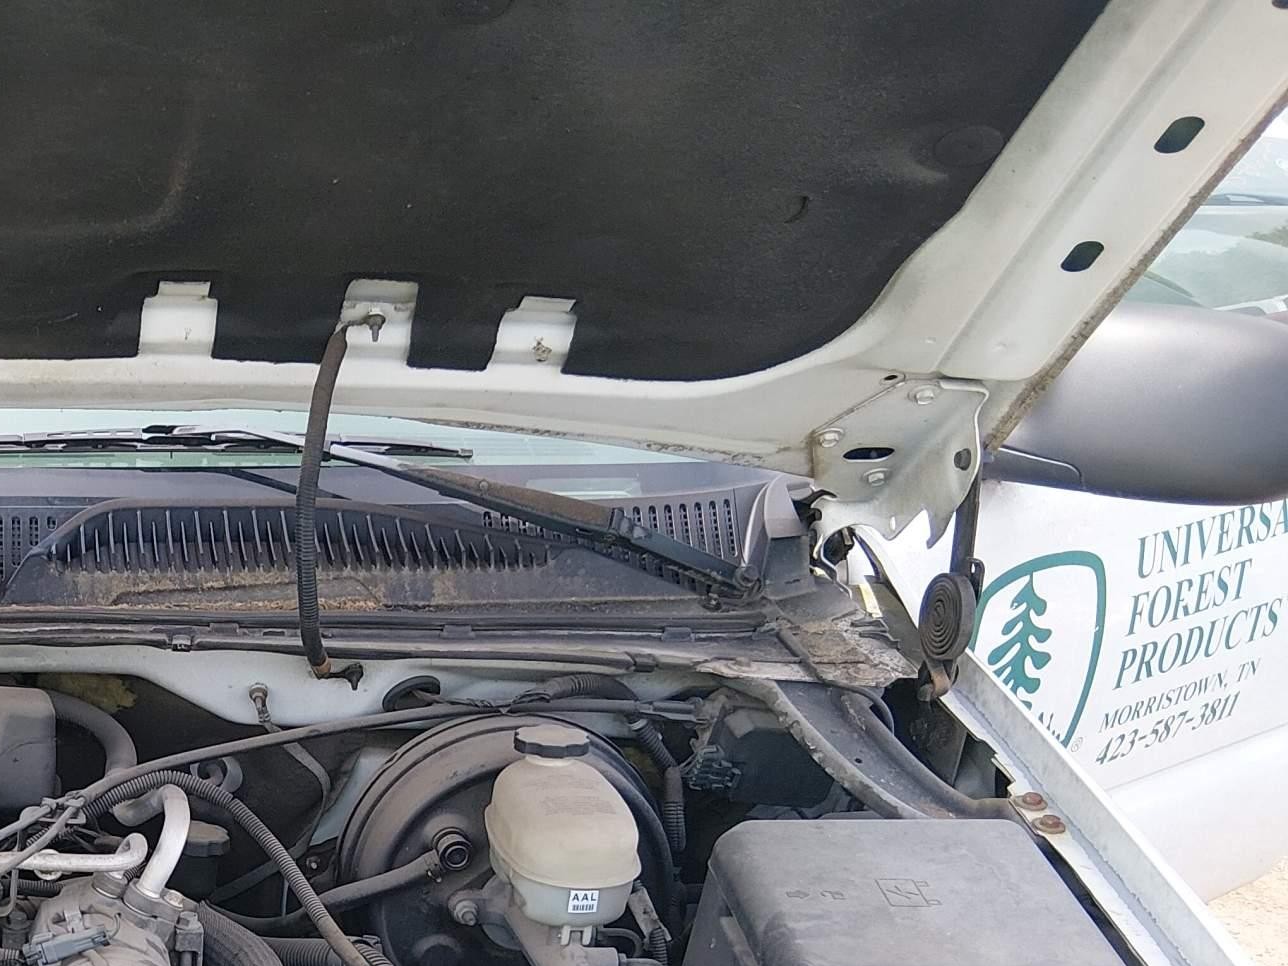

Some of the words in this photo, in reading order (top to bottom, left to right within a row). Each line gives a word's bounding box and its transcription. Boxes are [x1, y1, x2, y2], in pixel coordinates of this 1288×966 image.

[1125, 559, 1252, 637] FOREST
[1112, 598, 1281, 690] PRODUCTS
[1096, 691, 1240, 765] 423-587-3811
[1098, 672, 1227, 733] MORRISTOWN,
[1237, 658, 1262, 683] TN
[572, 893, 598, 902] AAL
